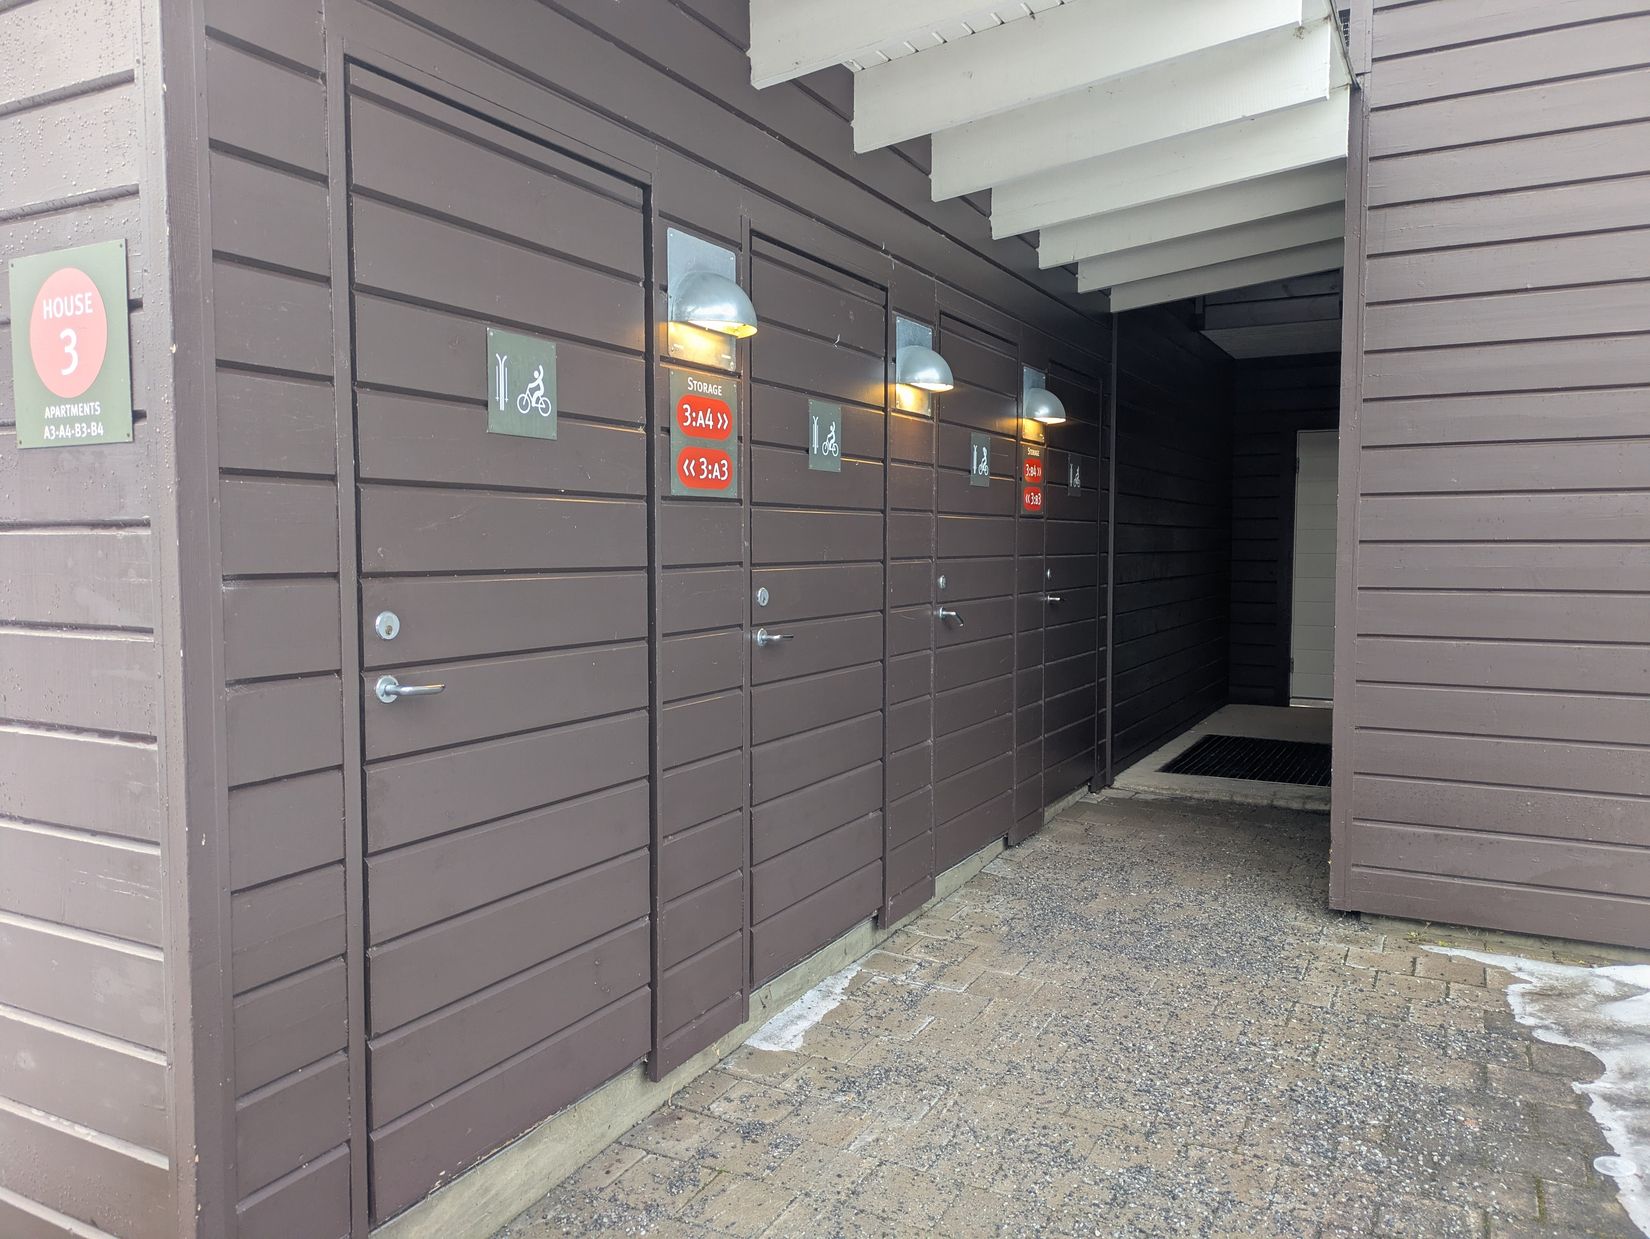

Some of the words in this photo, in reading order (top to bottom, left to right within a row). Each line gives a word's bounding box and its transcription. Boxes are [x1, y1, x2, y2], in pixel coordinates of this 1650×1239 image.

[43, 292, 93, 319] HOUSE
[59, 328, 79, 376] 3
[44, 401, 101, 419] APARTMENTS
[682, 404, 713, 430] 3:A4
[699, 457, 729, 481] 3:A3
